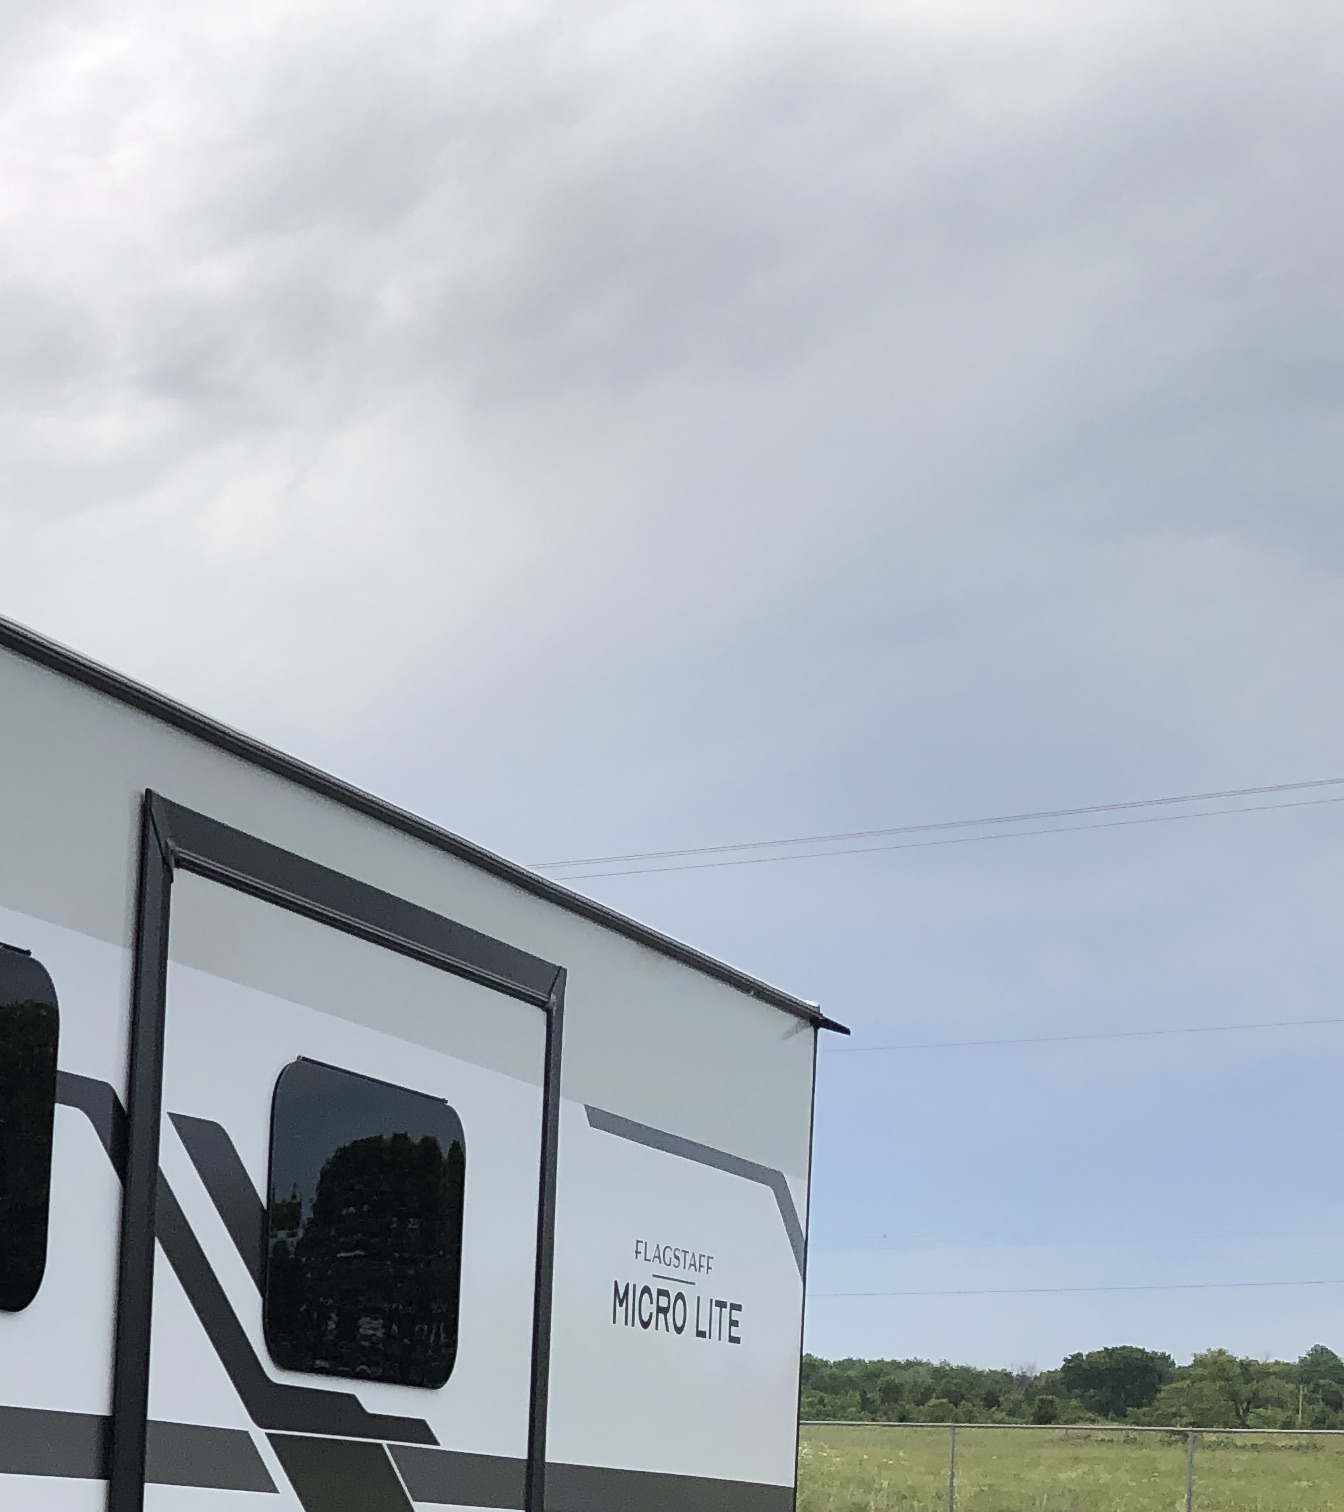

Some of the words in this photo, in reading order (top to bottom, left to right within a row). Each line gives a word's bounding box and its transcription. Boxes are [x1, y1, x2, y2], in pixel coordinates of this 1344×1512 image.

[633, 1238, 715, 1276] FLAGSTAFF
[612, 1279, 688, 1336] MICRO
[694, 1296, 743, 1346] LITE
